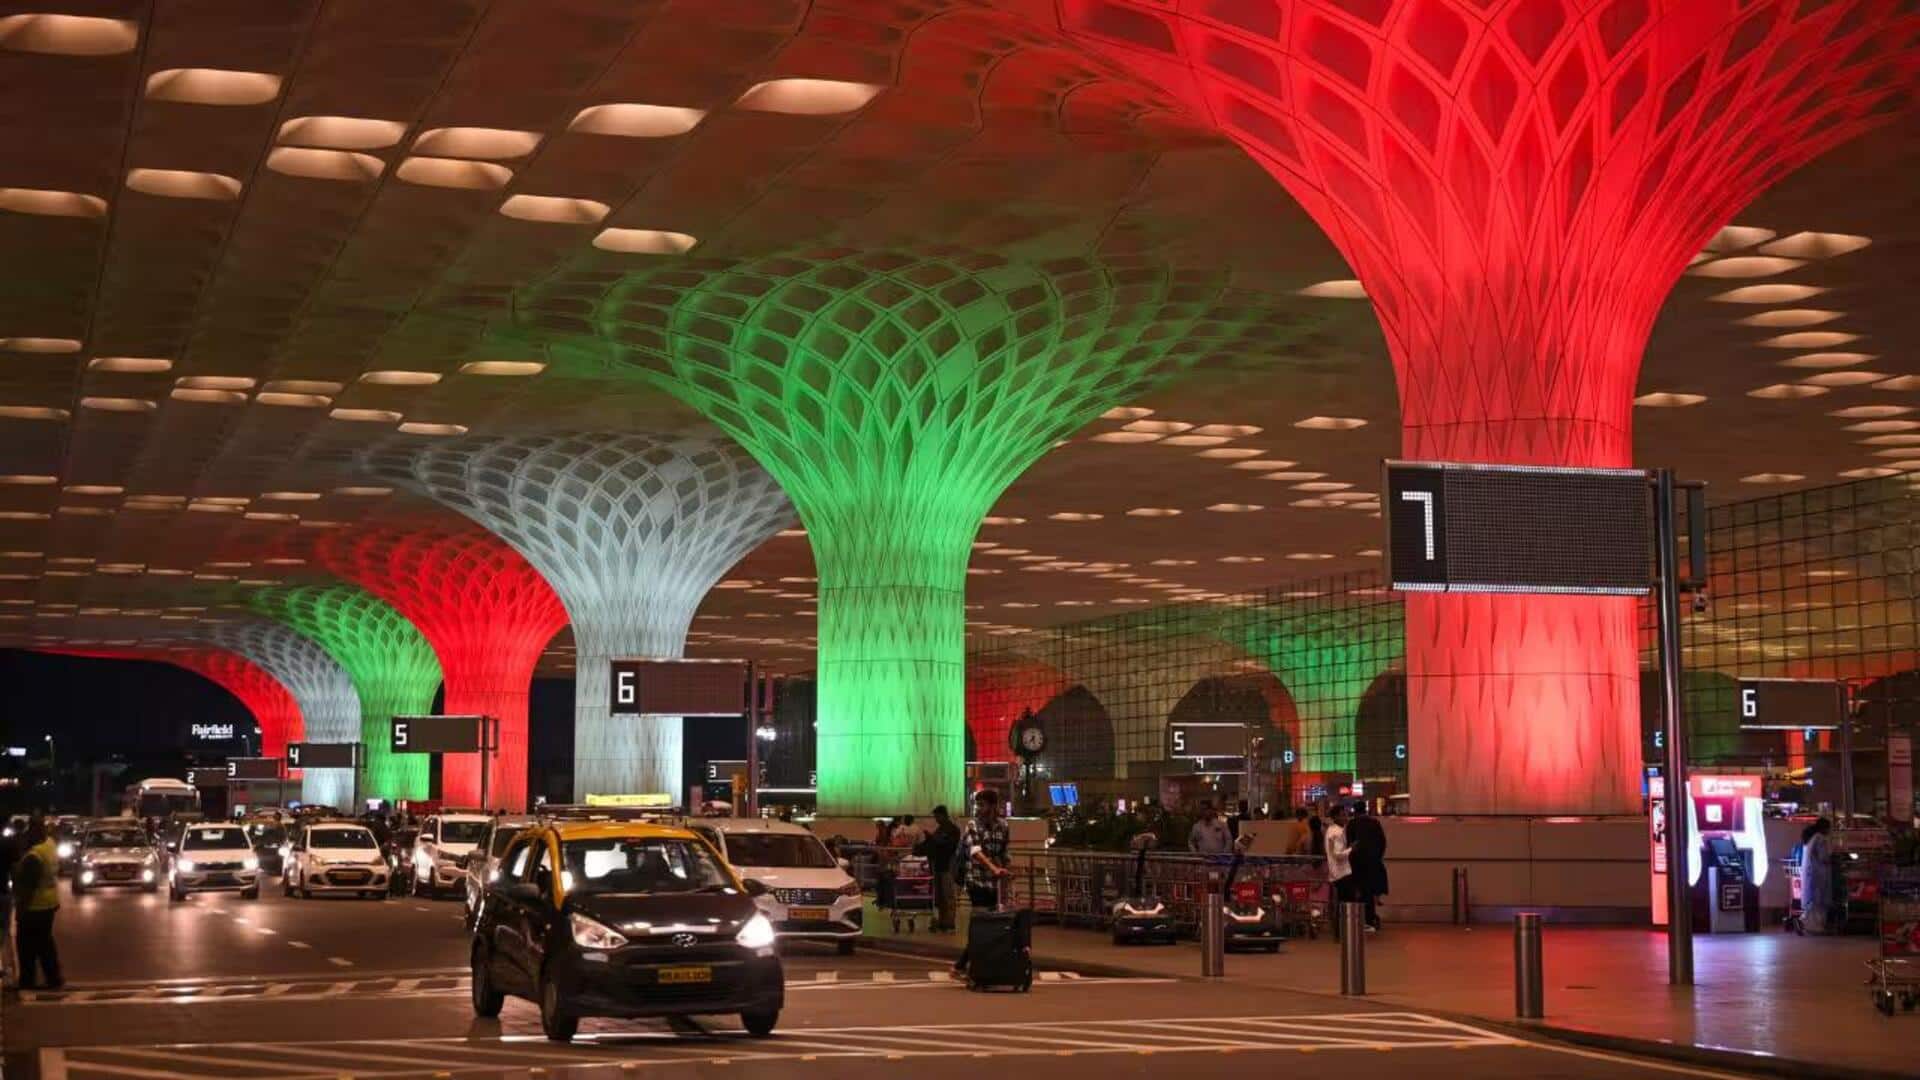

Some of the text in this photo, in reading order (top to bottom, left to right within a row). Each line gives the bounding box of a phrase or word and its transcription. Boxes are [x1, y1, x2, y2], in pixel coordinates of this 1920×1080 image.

[1402, 491, 1434, 560] 7
[618, 671, 635, 704] 6
[1742, 689, 1756, 717] 6
[395, 724, 407, 745] 5
[1174, 731, 1184, 751] 5
[289, 747, 299, 764] 4
[1284, 750, 1293, 764] B
[1395, 744, 1405, 759] C
[187, 771, 195, 784] 2
[228, 762, 236, 777] 3
[709, 765, 717, 778] 3
